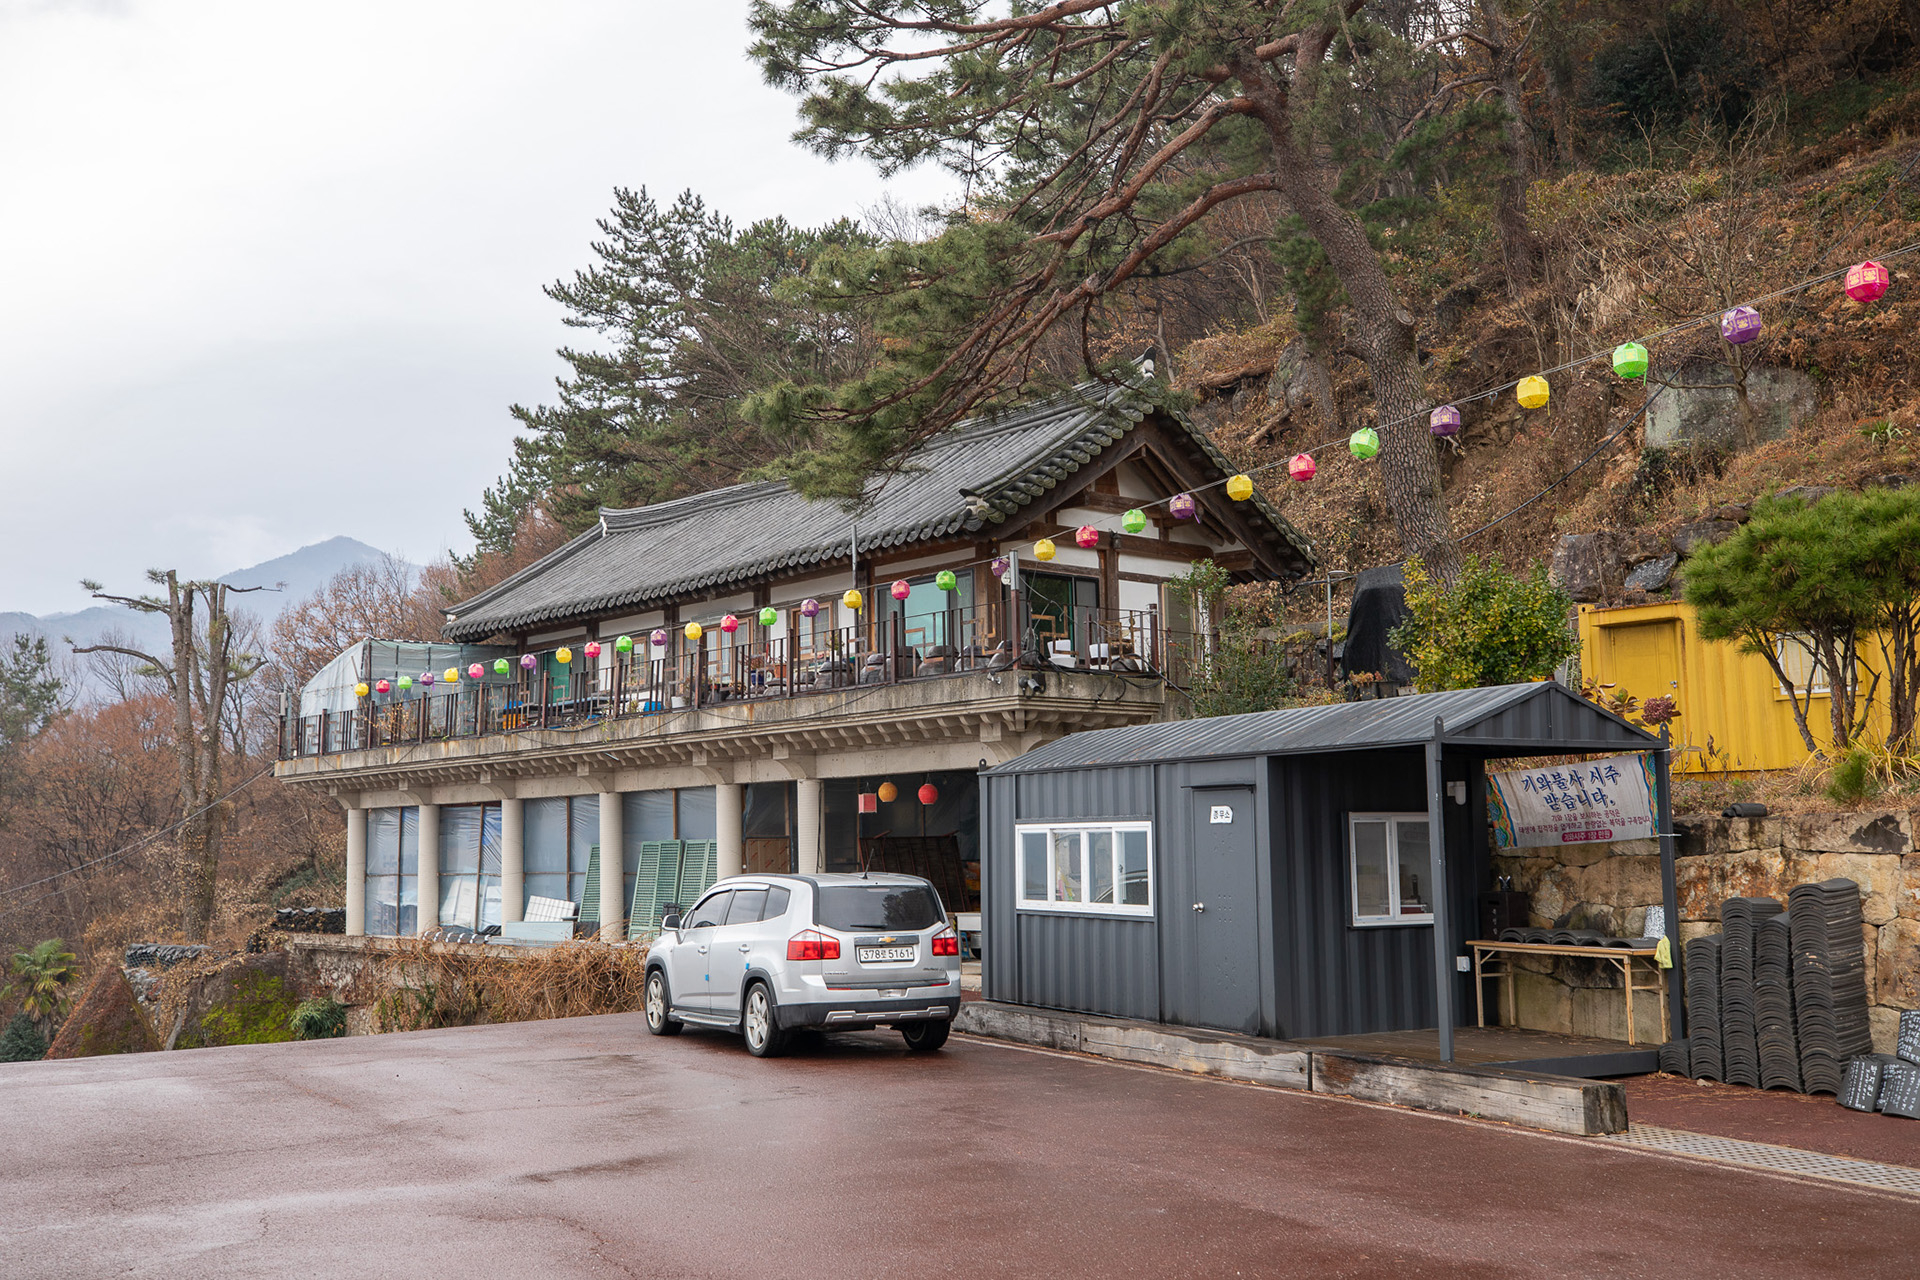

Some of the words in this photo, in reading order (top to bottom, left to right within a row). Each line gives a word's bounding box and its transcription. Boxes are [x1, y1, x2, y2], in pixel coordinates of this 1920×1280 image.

[1521, 769, 1584, 794] 기와불사
[1589, 765, 1621, 787] 시주
[1543, 787, 1616, 812] 받습니다.
[1213, 809, 1230, 819] 종무소
[1551, 814, 1562, 822] 기와
[1564, 813, 1578, 822] 1장을
[1579, 811, 1602, 820] 보시하는
[1604, 808, 1621, 819] 공덕은
[888, 948, 910, 959] 5161
